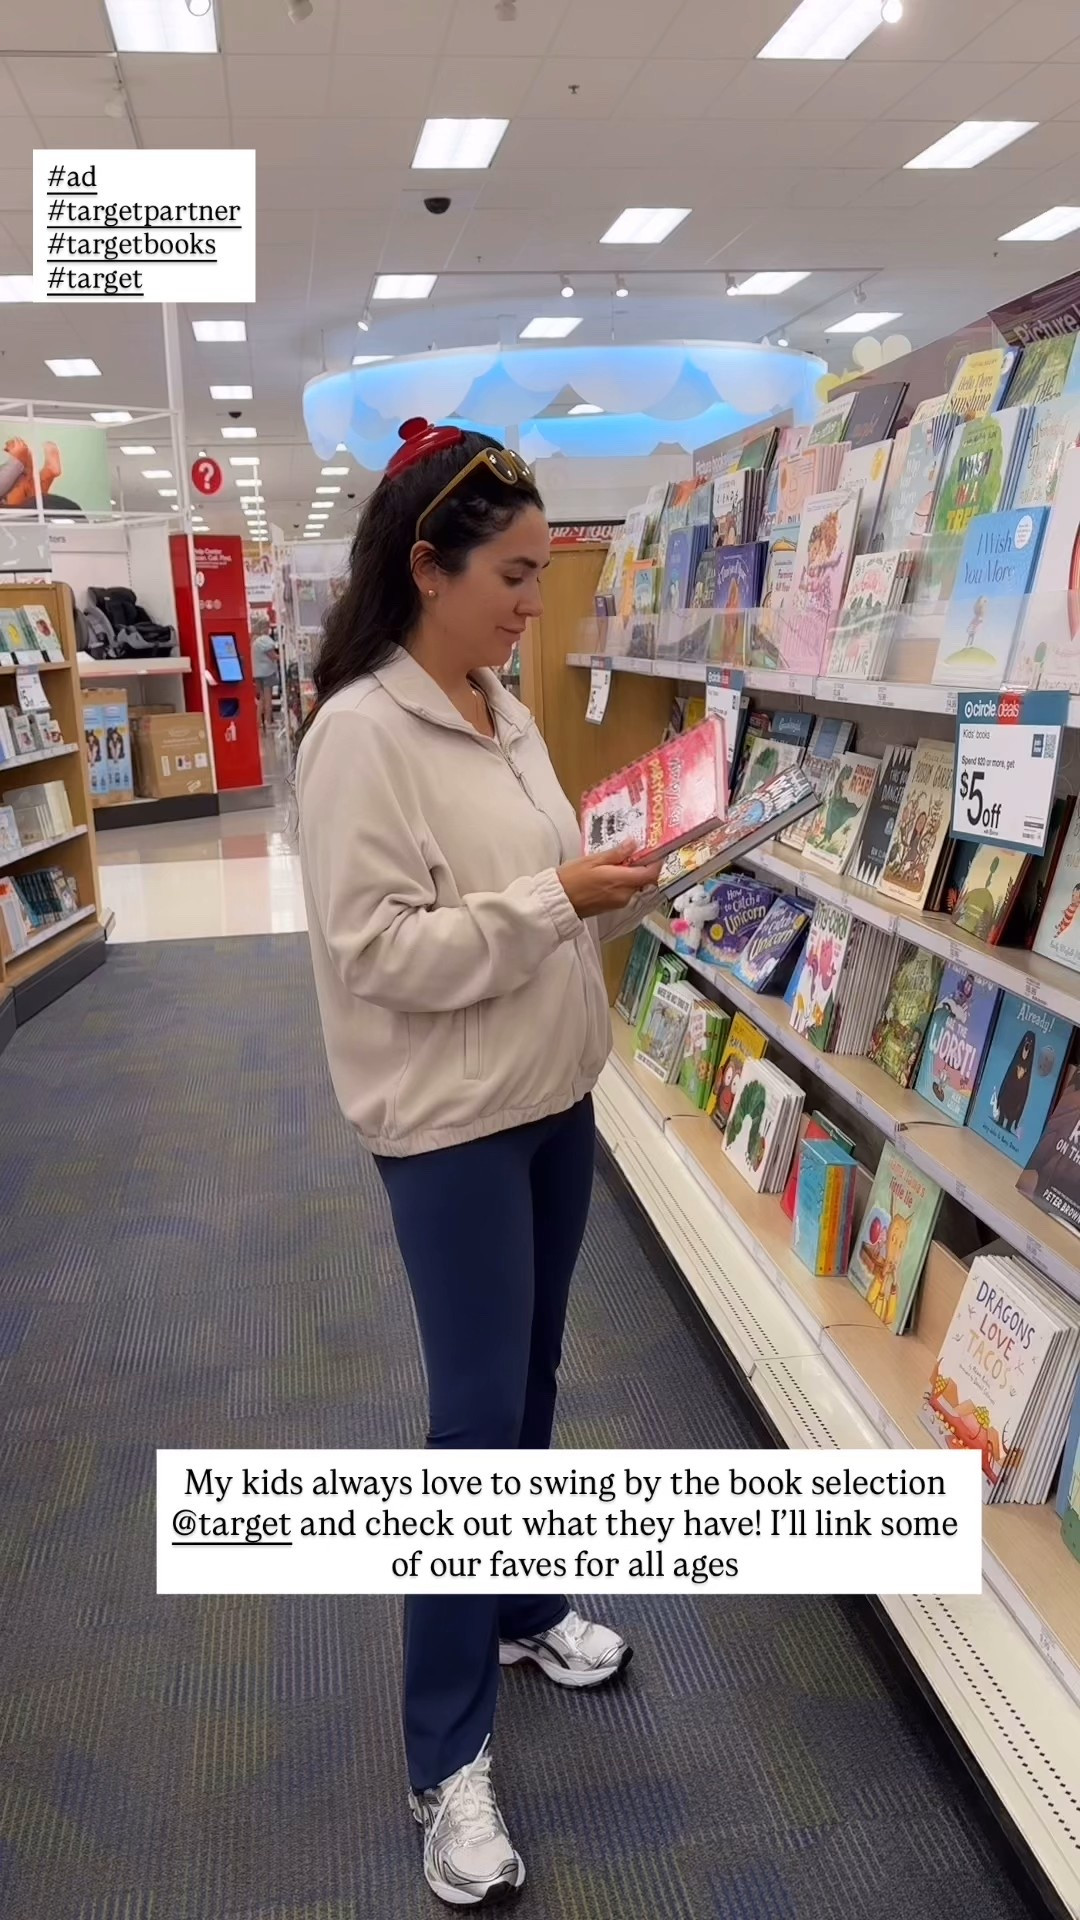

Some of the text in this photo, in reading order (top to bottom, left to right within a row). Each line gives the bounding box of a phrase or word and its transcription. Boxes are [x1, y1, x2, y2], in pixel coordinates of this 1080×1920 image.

[1014, 311, 1078, 346] Picture
[984, 528, 1012, 556] Wish
[964, 558, 1016, 584] You More
[973, 699, 1019, 718] circle deals
[975, 729, 990, 740] books
[961, 755, 1015, 770] Spend $20 or more, get
[960, 769, 985, 827] $5
[982, 803, 1002, 829] off
[724, 904, 732, 912] to
[732, 892, 755, 912] Catch
[727, 888, 742, 900] How
[724, 905, 767, 936] Unicorn
[749, 928, 795, 961] Unicorn
[957, 1023, 968, 1039] THE
[1017, 1002, 1056, 1034] Already!
[929, 1022, 976, 1079] WORST!
[1056, 1138, 1080, 1166] ON TH
[904, 1189, 913, 1209] lie
[1042, 1188, 1062, 1211] PETER
[976, 1280, 1035, 1350] DRAGONS
[979, 1313, 1016, 1362] LOVE
[963, 1328, 1012, 1390] TACOS
